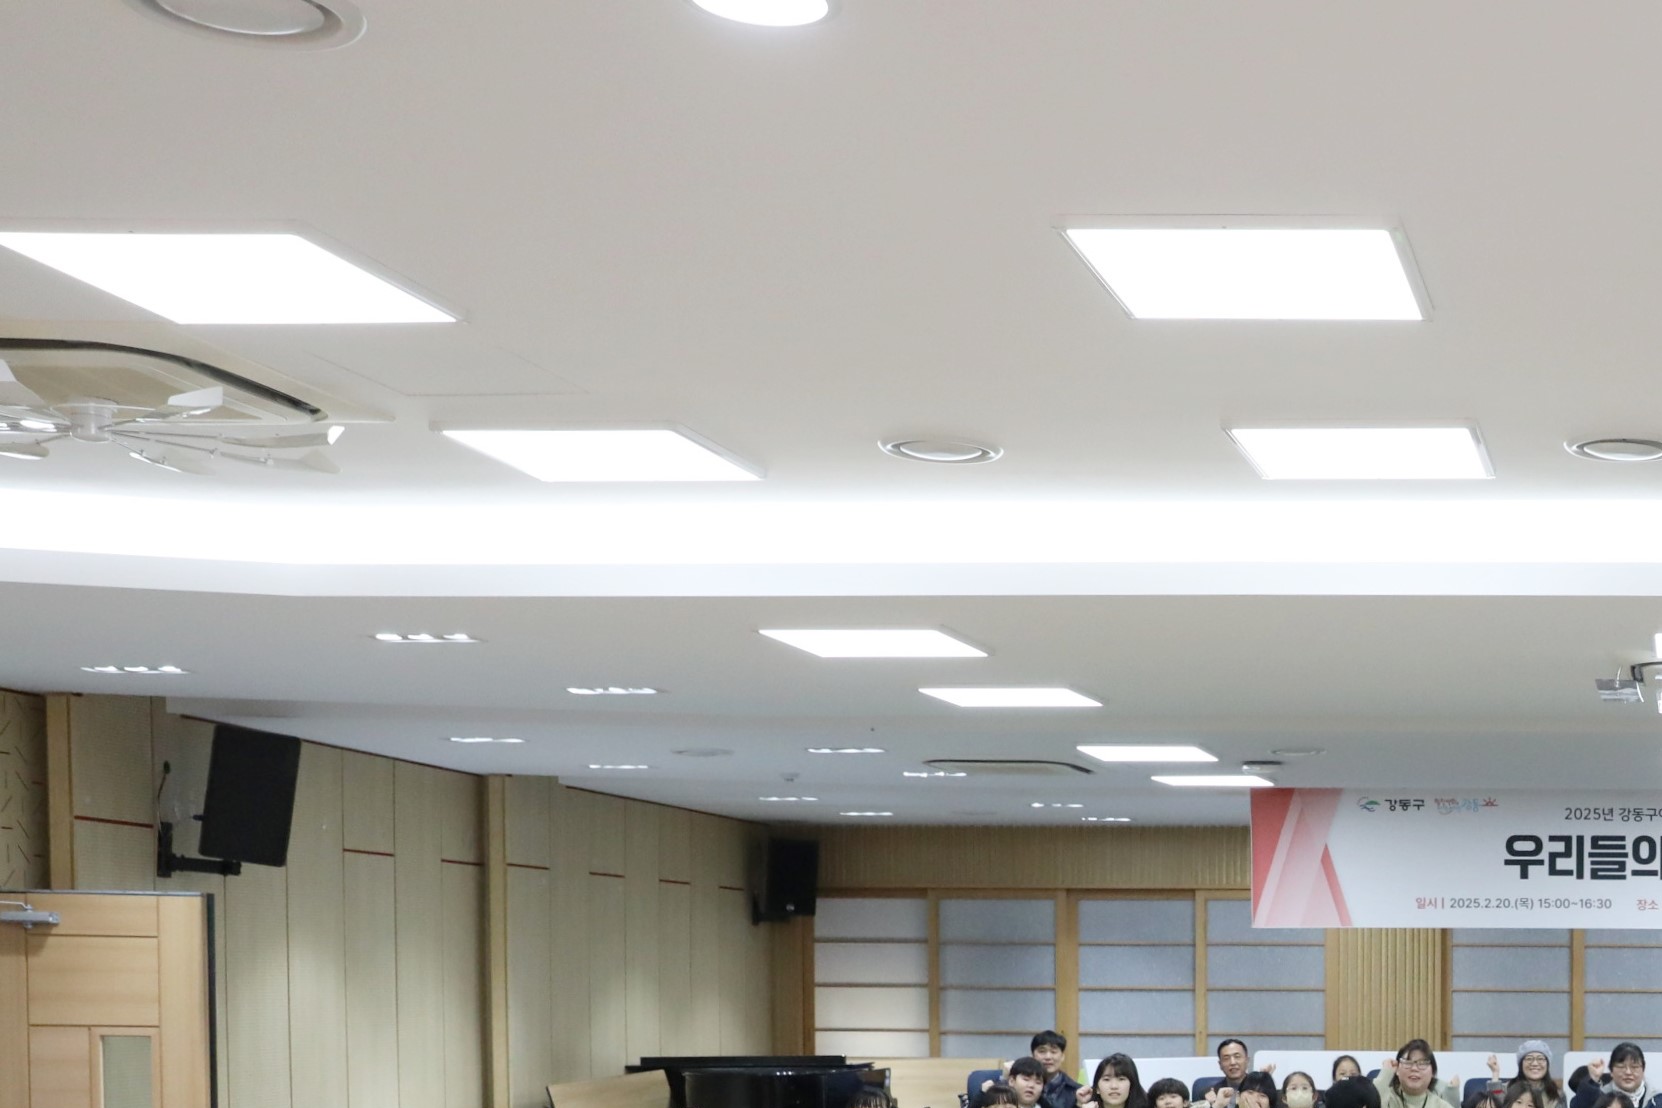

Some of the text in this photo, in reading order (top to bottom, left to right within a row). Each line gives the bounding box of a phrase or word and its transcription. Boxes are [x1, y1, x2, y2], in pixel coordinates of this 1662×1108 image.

[1384, 798, 1426, 811] 강동구
[1564, 807, 1614, 822] 2025년
[1416, 897, 1612, 911] 일시 2025.2.20.(목) 15:00~16:30
[1637, 899, 1659, 911] 장소
